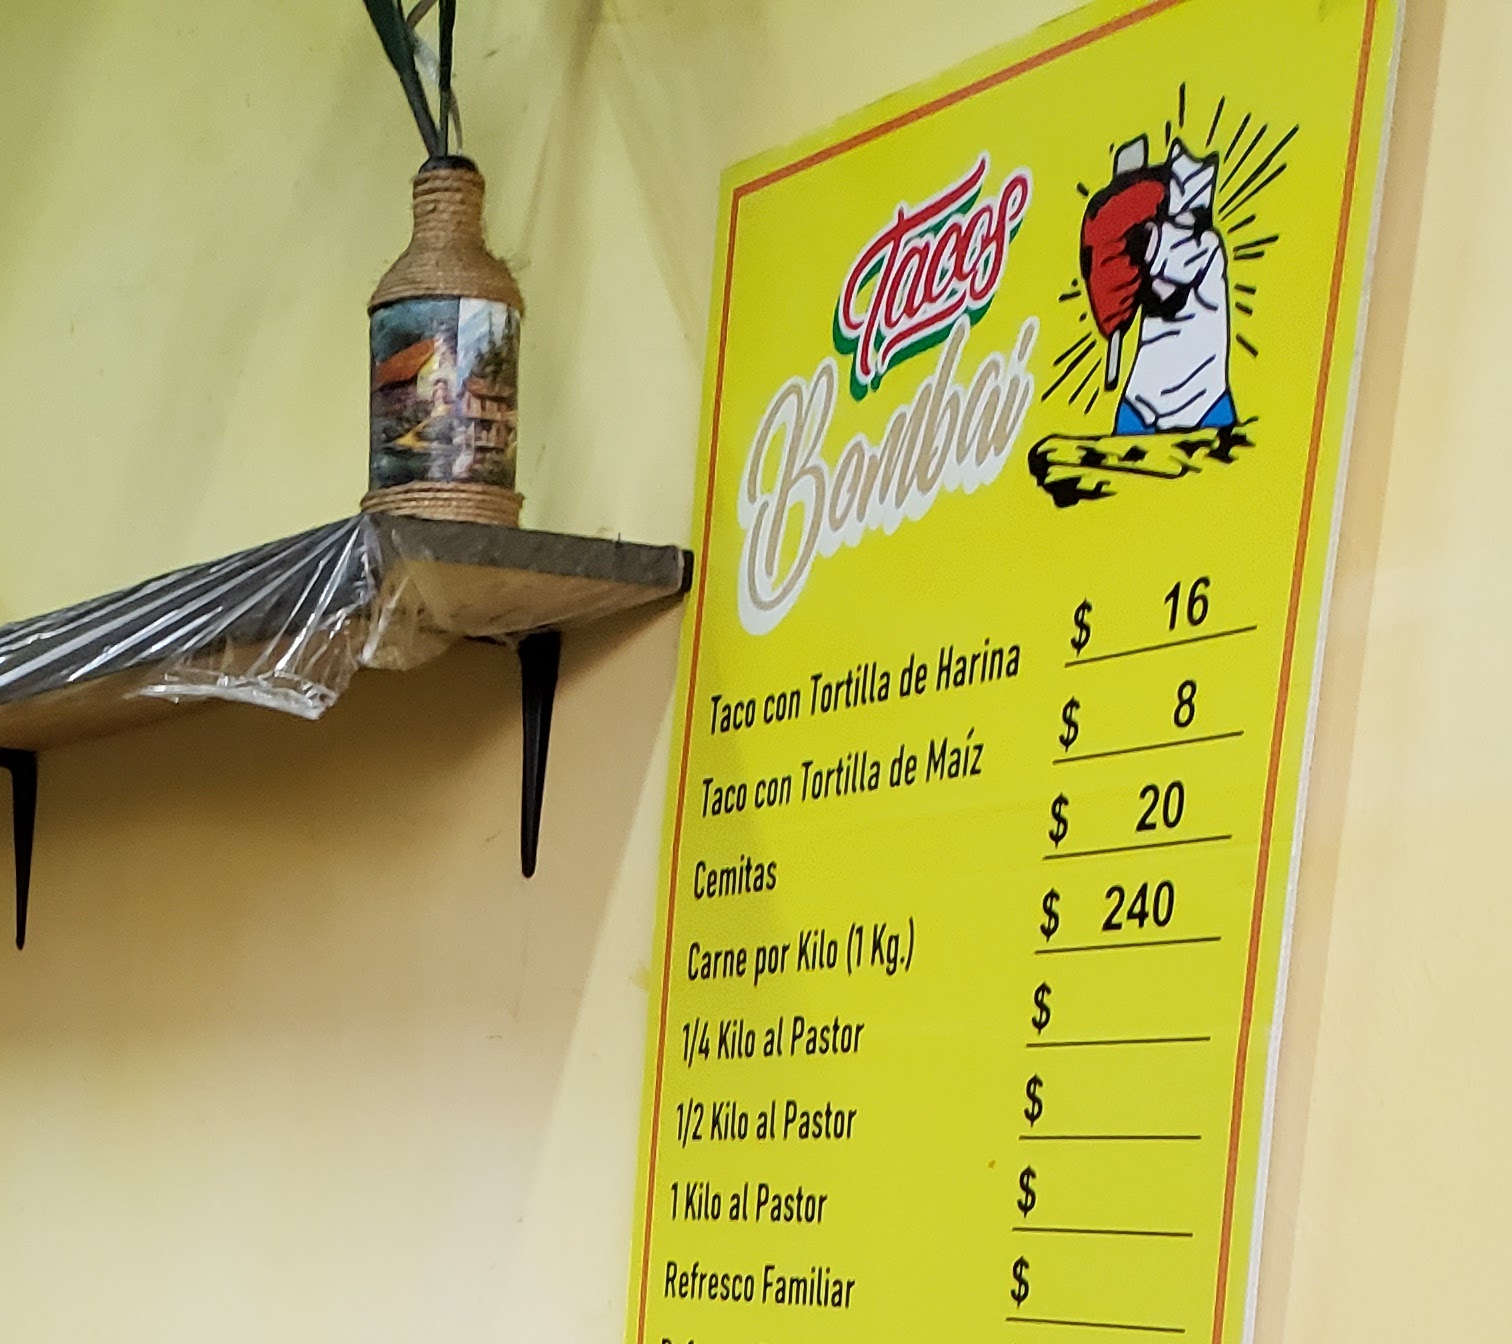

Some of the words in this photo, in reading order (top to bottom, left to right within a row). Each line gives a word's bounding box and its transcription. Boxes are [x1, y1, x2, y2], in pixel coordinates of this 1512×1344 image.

[834, 152, 1031, 392] Tacos
[710, 694, 757, 736] Taco
[763, 688, 801, 725] con
[810, 661, 891, 716] Tortilla
[899, 652, 928, 698] de
[935, 637, 1021, 692] Harina
[1070, 597, 1093, 658] $
[1164, 576, 1211, 632] 16
[702, 777, 748, 819] Taco
[754, 774, 792, 810] con
[801, 750, 881, 803] Tortilla
[889, 743, 918, 788] de
[925, 726, 984, 783] Maíz
[1058, 695, 1081, 753] $
[1173, 679, 1197, 729] 8
[693, 853, 777, 900] Cemitas
[1048, 792, 1070, 850] $
[1135, 780, 1185, 833] 20
[687, 941, 747, 982] Carne
[753, 942, 791, 988] por
[796, 928, 838, 973] Kilo
[846, 922, 864, 977] (1
[870, 915, 915, 976] Kg.)
[1039, 887, 1061, 943] $
[1101, 879, 1175, 932] 240
[682, 1016, 711, 1068] 1/4
[716, 1018, 756, 1060] Kilo
[763, 1015, 784, 1058] al
[790, 1015, 865, 1057] Pastor
[1031, 981, 1052, 1035] $
[676, 1098, 704, 1149] 1/2
[710, 1100, 749, 1141] Kilo
[756, 1100, 776, 1141] al
[783, 1099, 857, 1141] Pastor
[1023, 1074, 1044, 1128] $
[670, 1181, 679, 1221] 1
[684, 1181, 722, 1221] Kilo
[728, 1181, 749, 1222] al
[755, 1182, 828, 1224] Pastor
[1016, 1165, 1037, 1219] $
[664, 1260, 755, 1303] Refresco
[761, 1264, 856, 1309] Familiar
[1010, 1255, 1030, 1309] $
